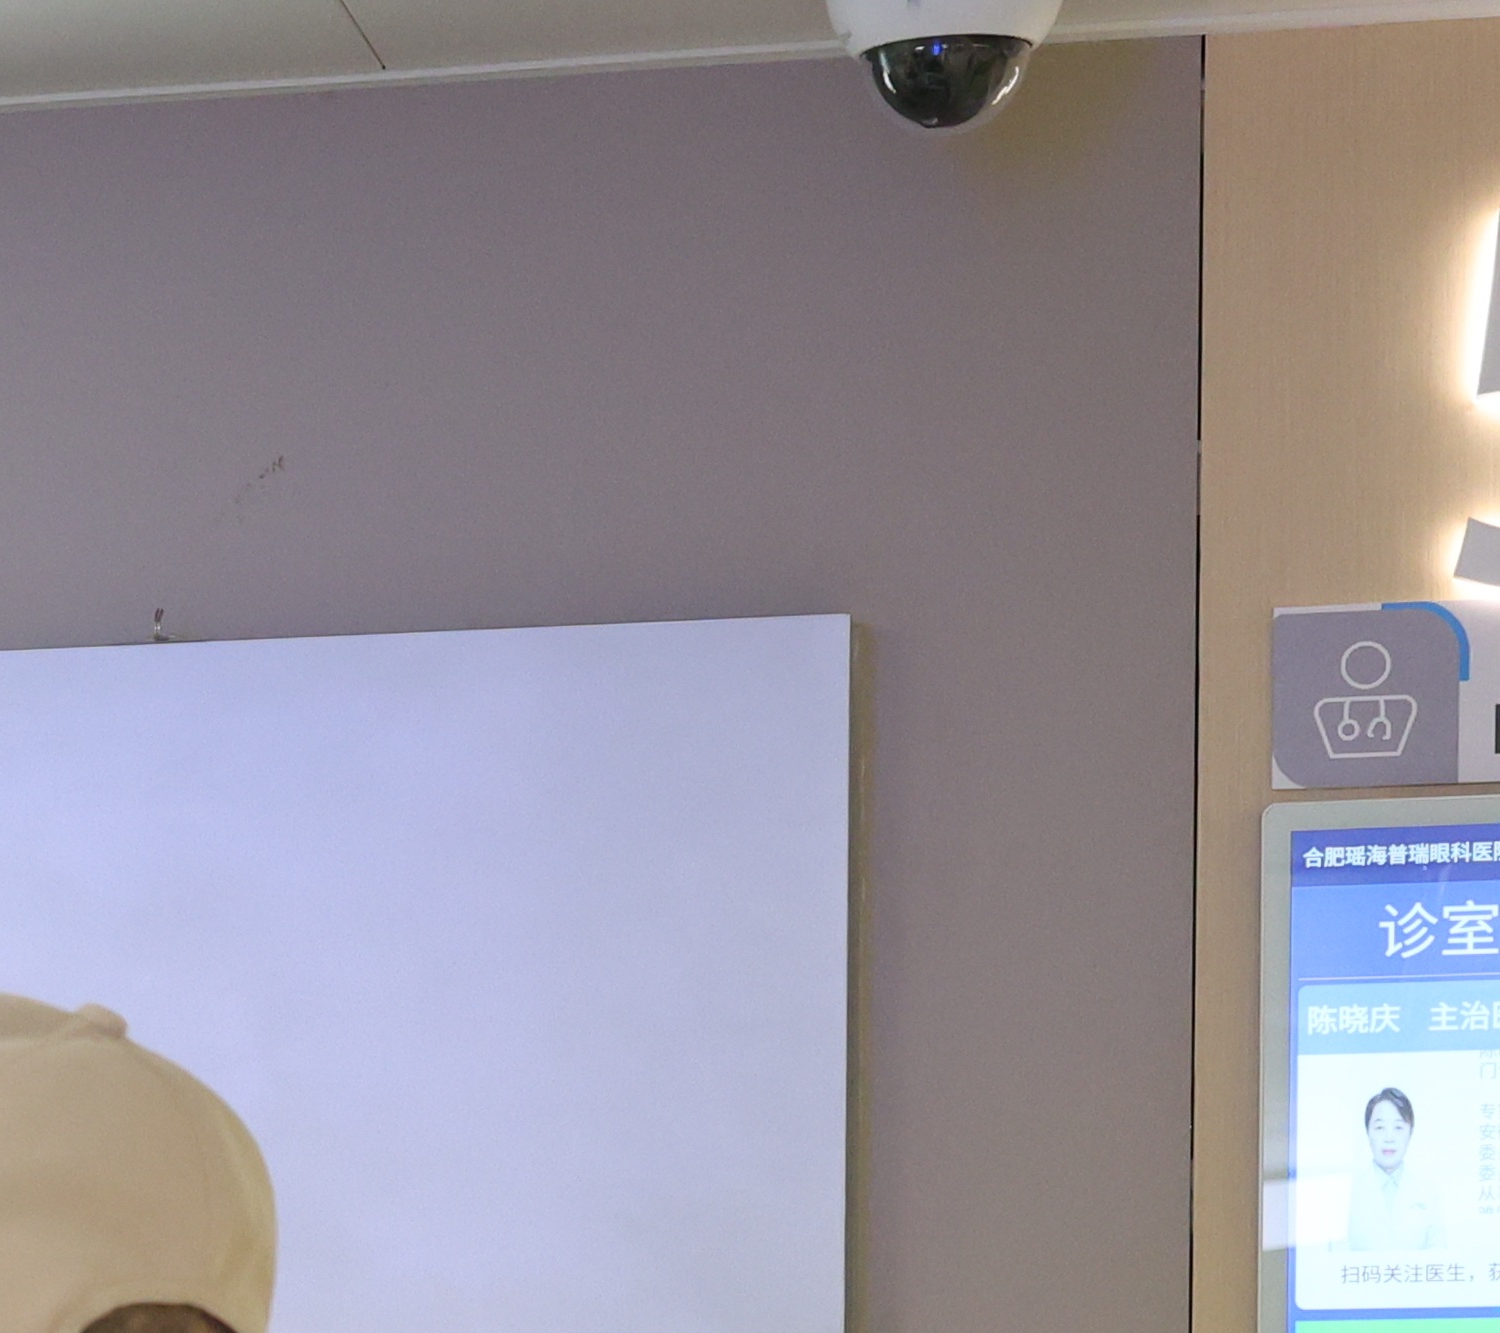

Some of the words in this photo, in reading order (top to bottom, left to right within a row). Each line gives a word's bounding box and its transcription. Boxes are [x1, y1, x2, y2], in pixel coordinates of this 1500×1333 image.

[1379, 900, 1500, 958] 诊室
[1307, 1003, 1400, 1035] 陈晓庆
